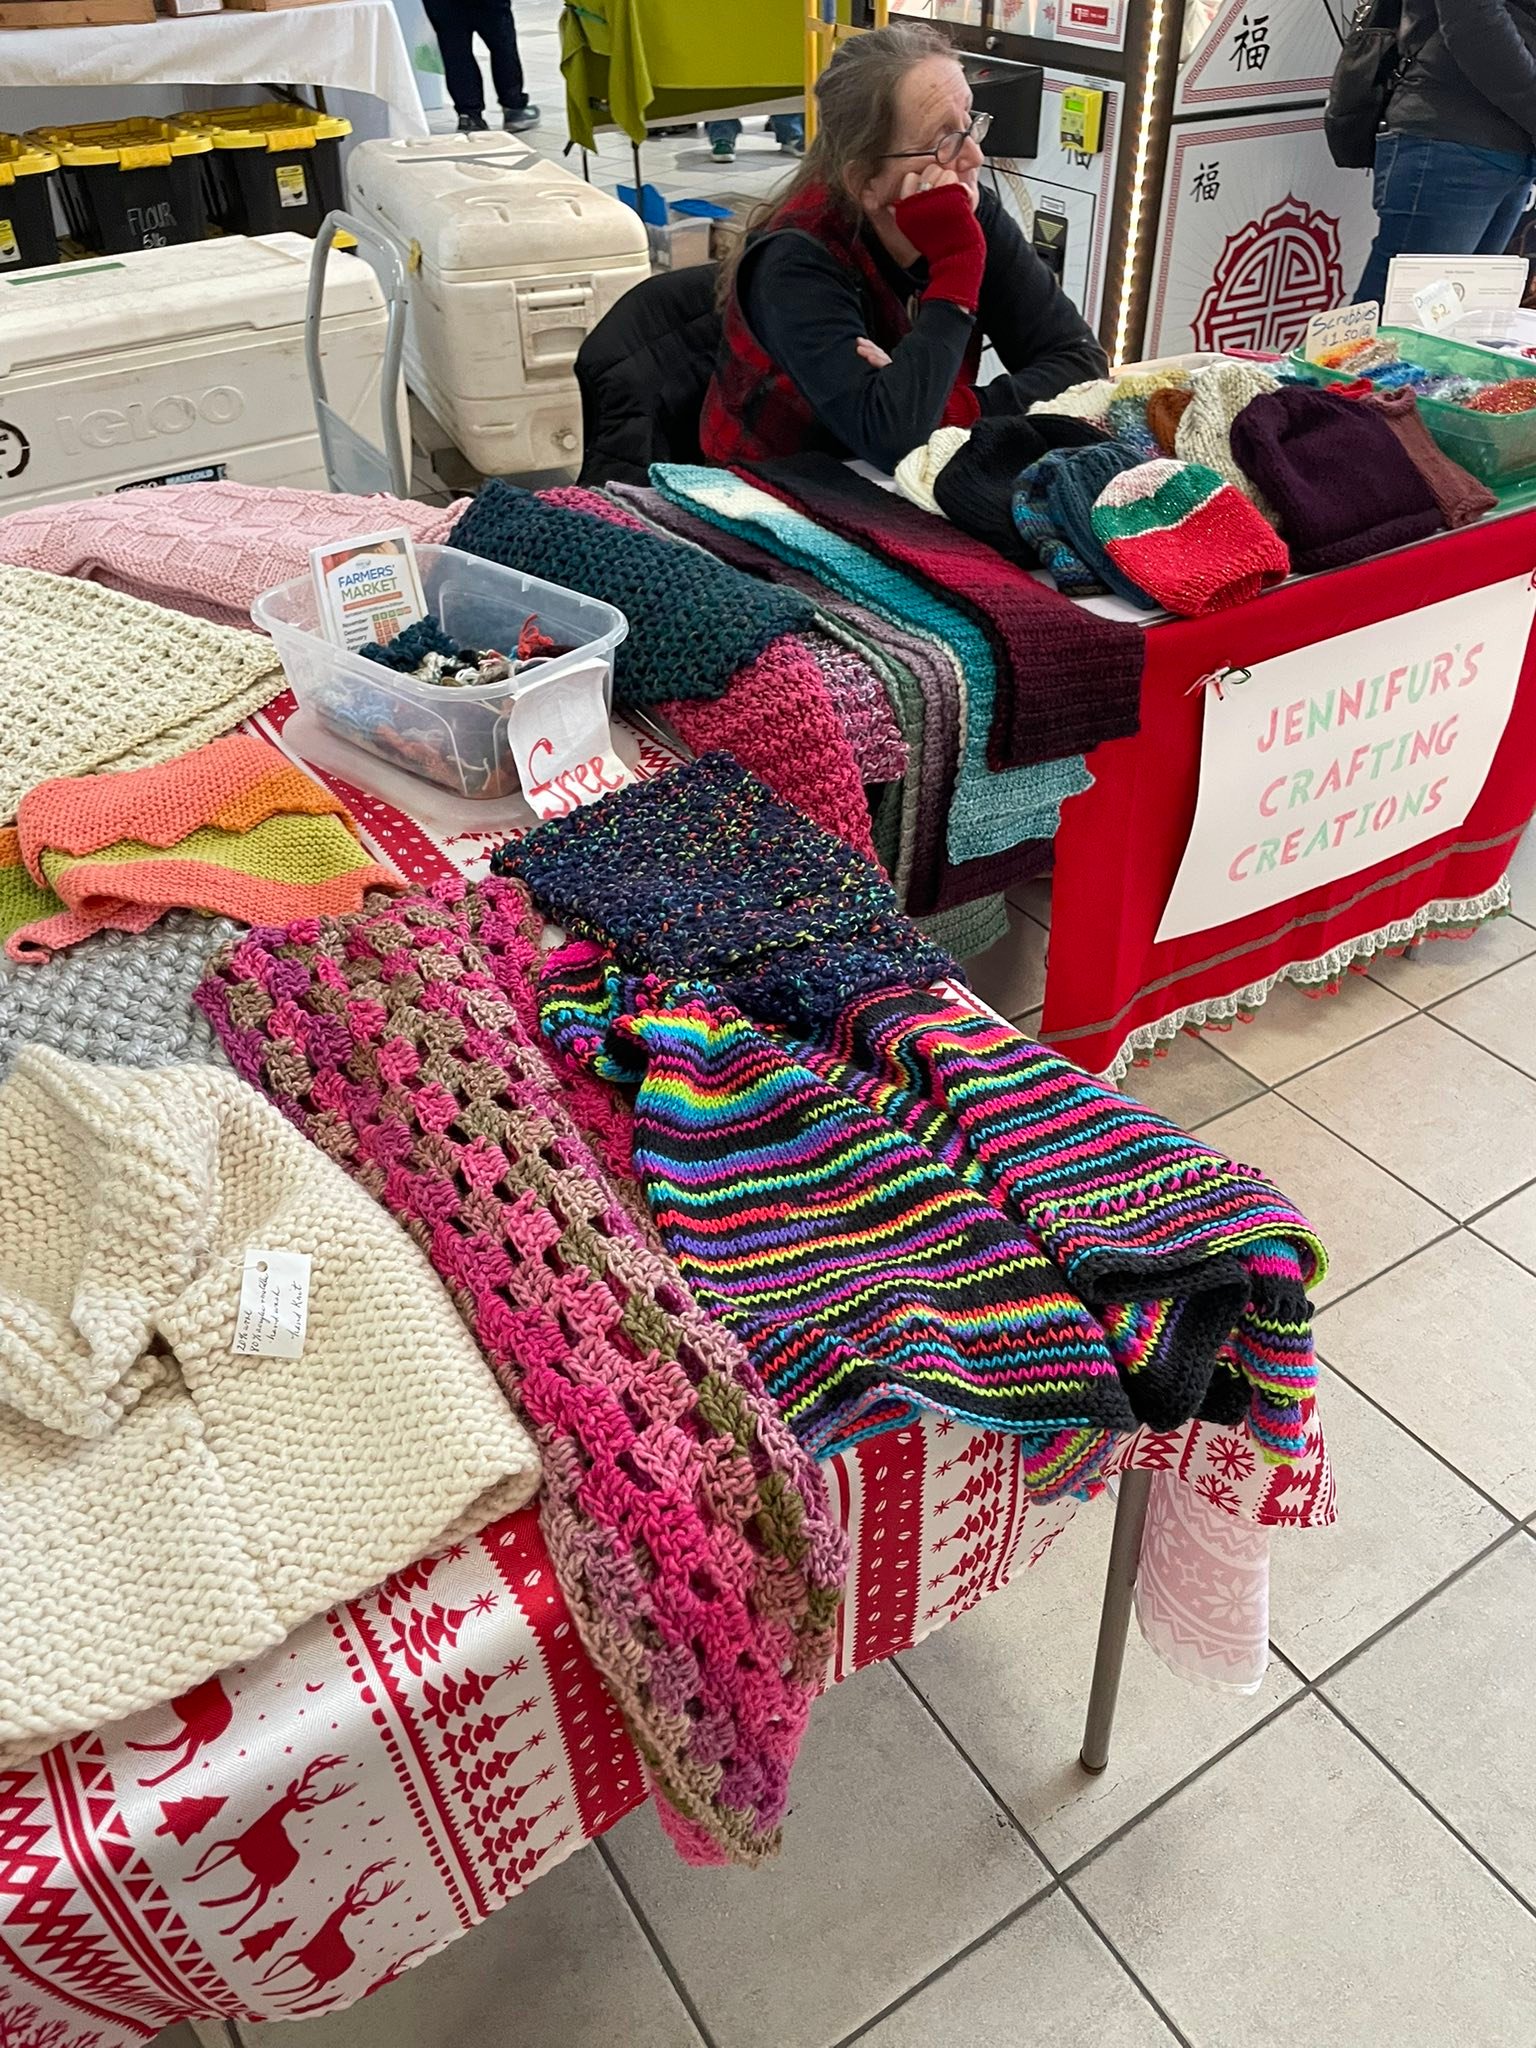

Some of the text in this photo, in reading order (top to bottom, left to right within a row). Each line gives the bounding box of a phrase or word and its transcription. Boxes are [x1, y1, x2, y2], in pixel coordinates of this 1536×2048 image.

[1229, 15, 1270, 71] 福
[1190, 161, 1220, 202] 福
[55, 385, 244, 456] IGLOO
[338, 564, 395, 588] FARMERS'
[341, 577, 398, 602] MARKET
[1257, 642, 1484, 753] JENNIFUR'S
[1259, 713, 1458, 817] CRAFTING
[1228, 776, 1449, 881] CREATIONS
